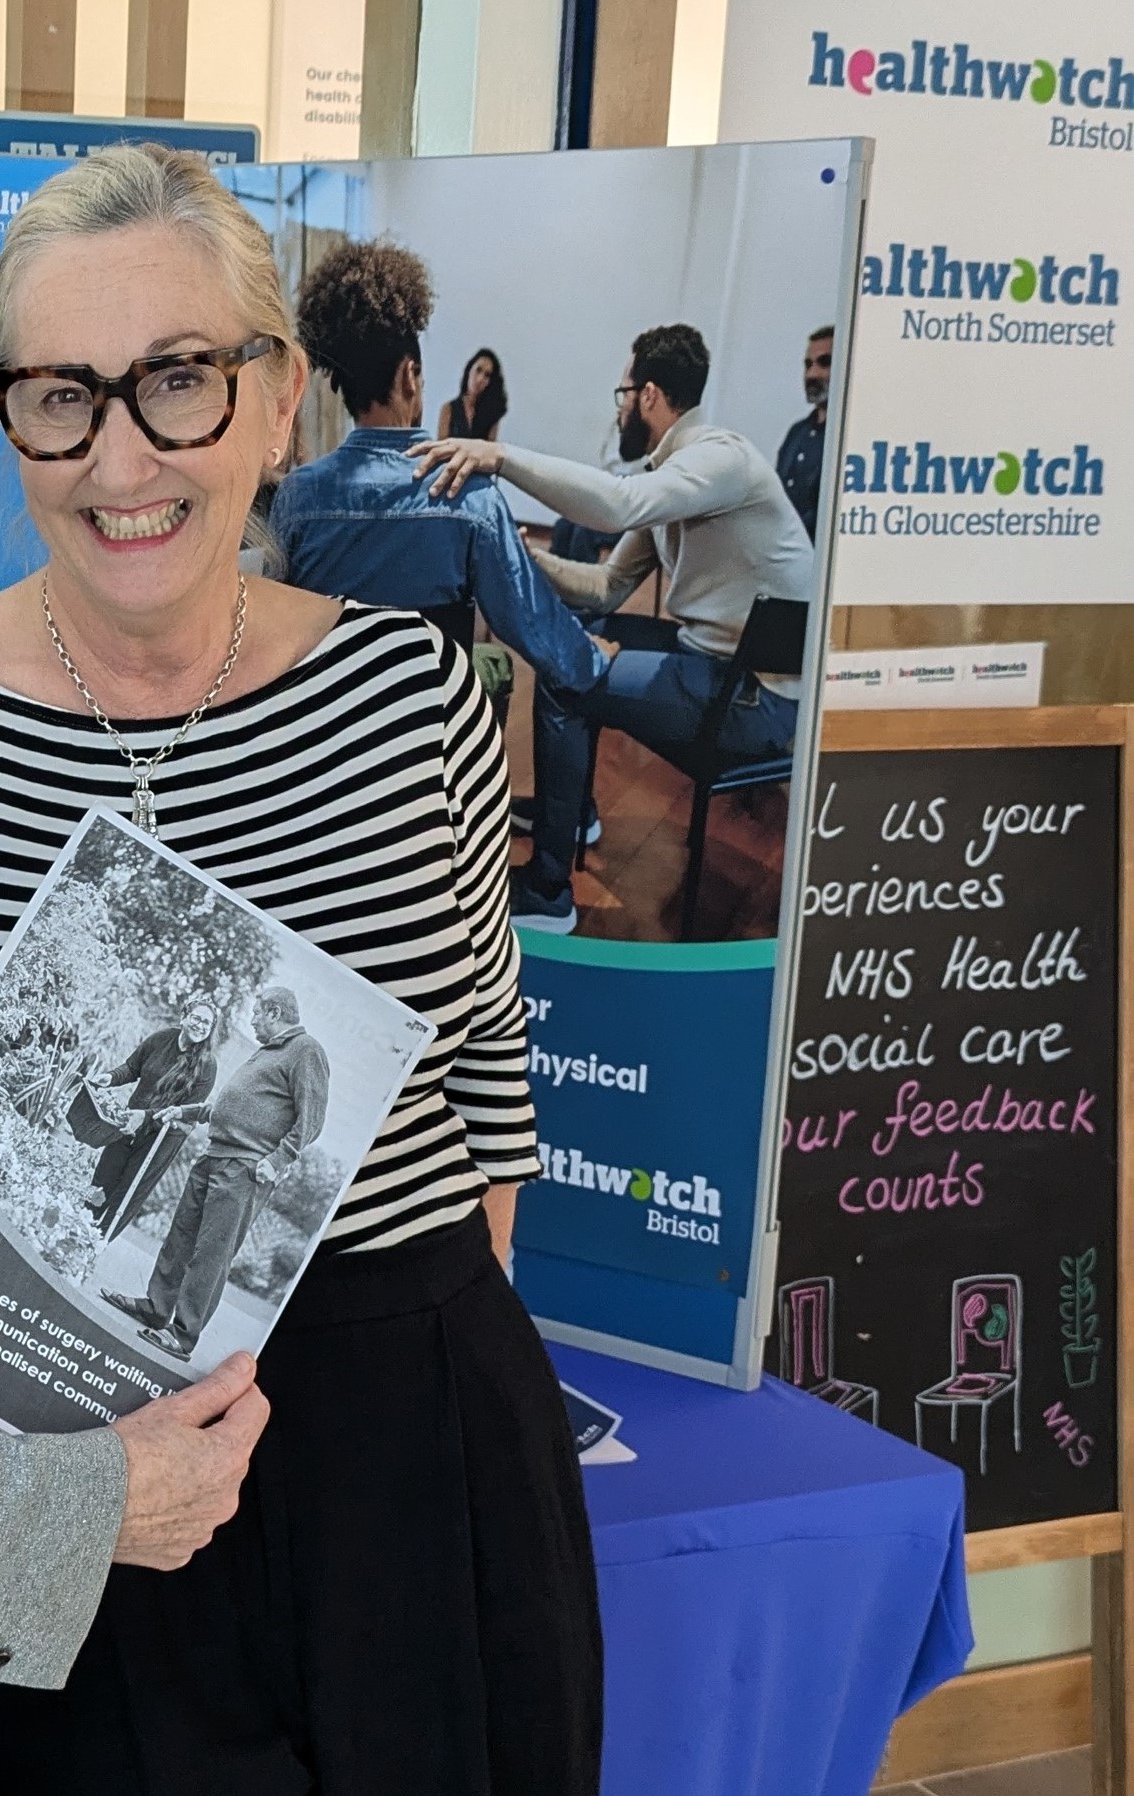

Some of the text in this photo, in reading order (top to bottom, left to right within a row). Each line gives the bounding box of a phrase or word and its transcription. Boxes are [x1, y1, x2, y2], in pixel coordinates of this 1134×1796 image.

[305, 88, 351, 104] health
[306, 67, 332, 81] Our
[808, 31, 1134, 110] healthwatch
[1048, 117, 1134, 152] Bristol
[901, 309, 1116, 347] North Somerset
[883, 505, 1101, 536] Gloucestershire
[965, 803, 1086, 867] your
[825, 926, 1087, 1000] NHS Health
[525, 1045, 648, 1094] hysical
[791, 1013, 1071, 1080] social care
[872, 1079, 1097, 1156] feedback
[838, 1150, 985, 1213] counts
[646, 1209, 720, 1245] Bristol
[21, 1308, 41, 1324] of
[39, 1319, 102, 1361] surgery
[104, 1354, 163, 1399] waiting
[81, 1369, 118, 1396] and
[1042, 1401, 1095, 1467] NHS
